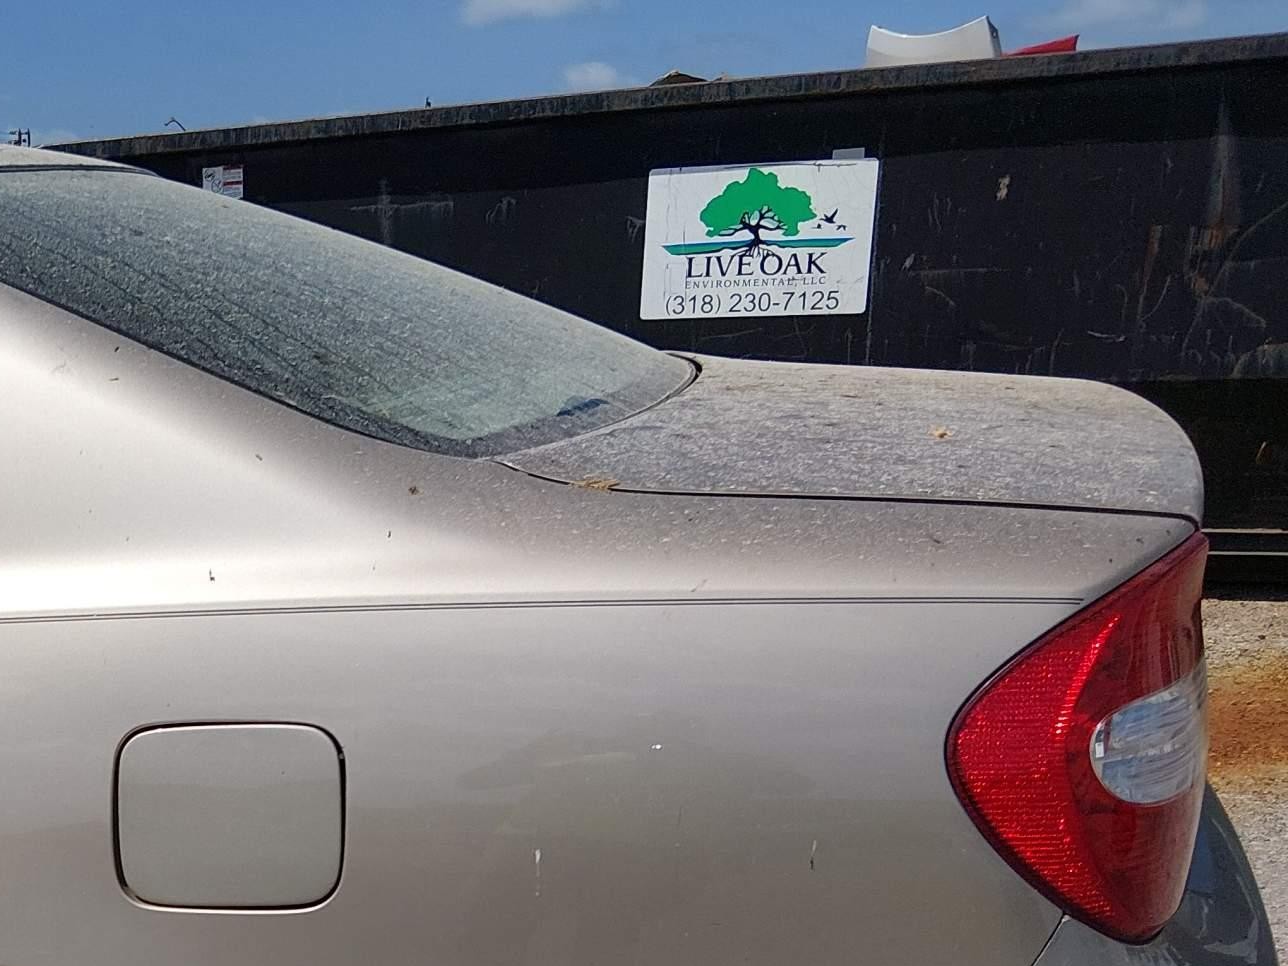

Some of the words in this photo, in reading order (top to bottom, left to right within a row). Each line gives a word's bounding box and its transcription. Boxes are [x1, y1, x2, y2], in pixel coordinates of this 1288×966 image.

[686, 255, 754, 279] LIVE
[760, 251, 828, 276] OAK
[685, 277, 798, 290] ENVIRONMENTAL,
[802, 276, 827, 286] LLC
[665, 293, 721, 316] (318)
[728, 290, 840, 313] 230-7125
